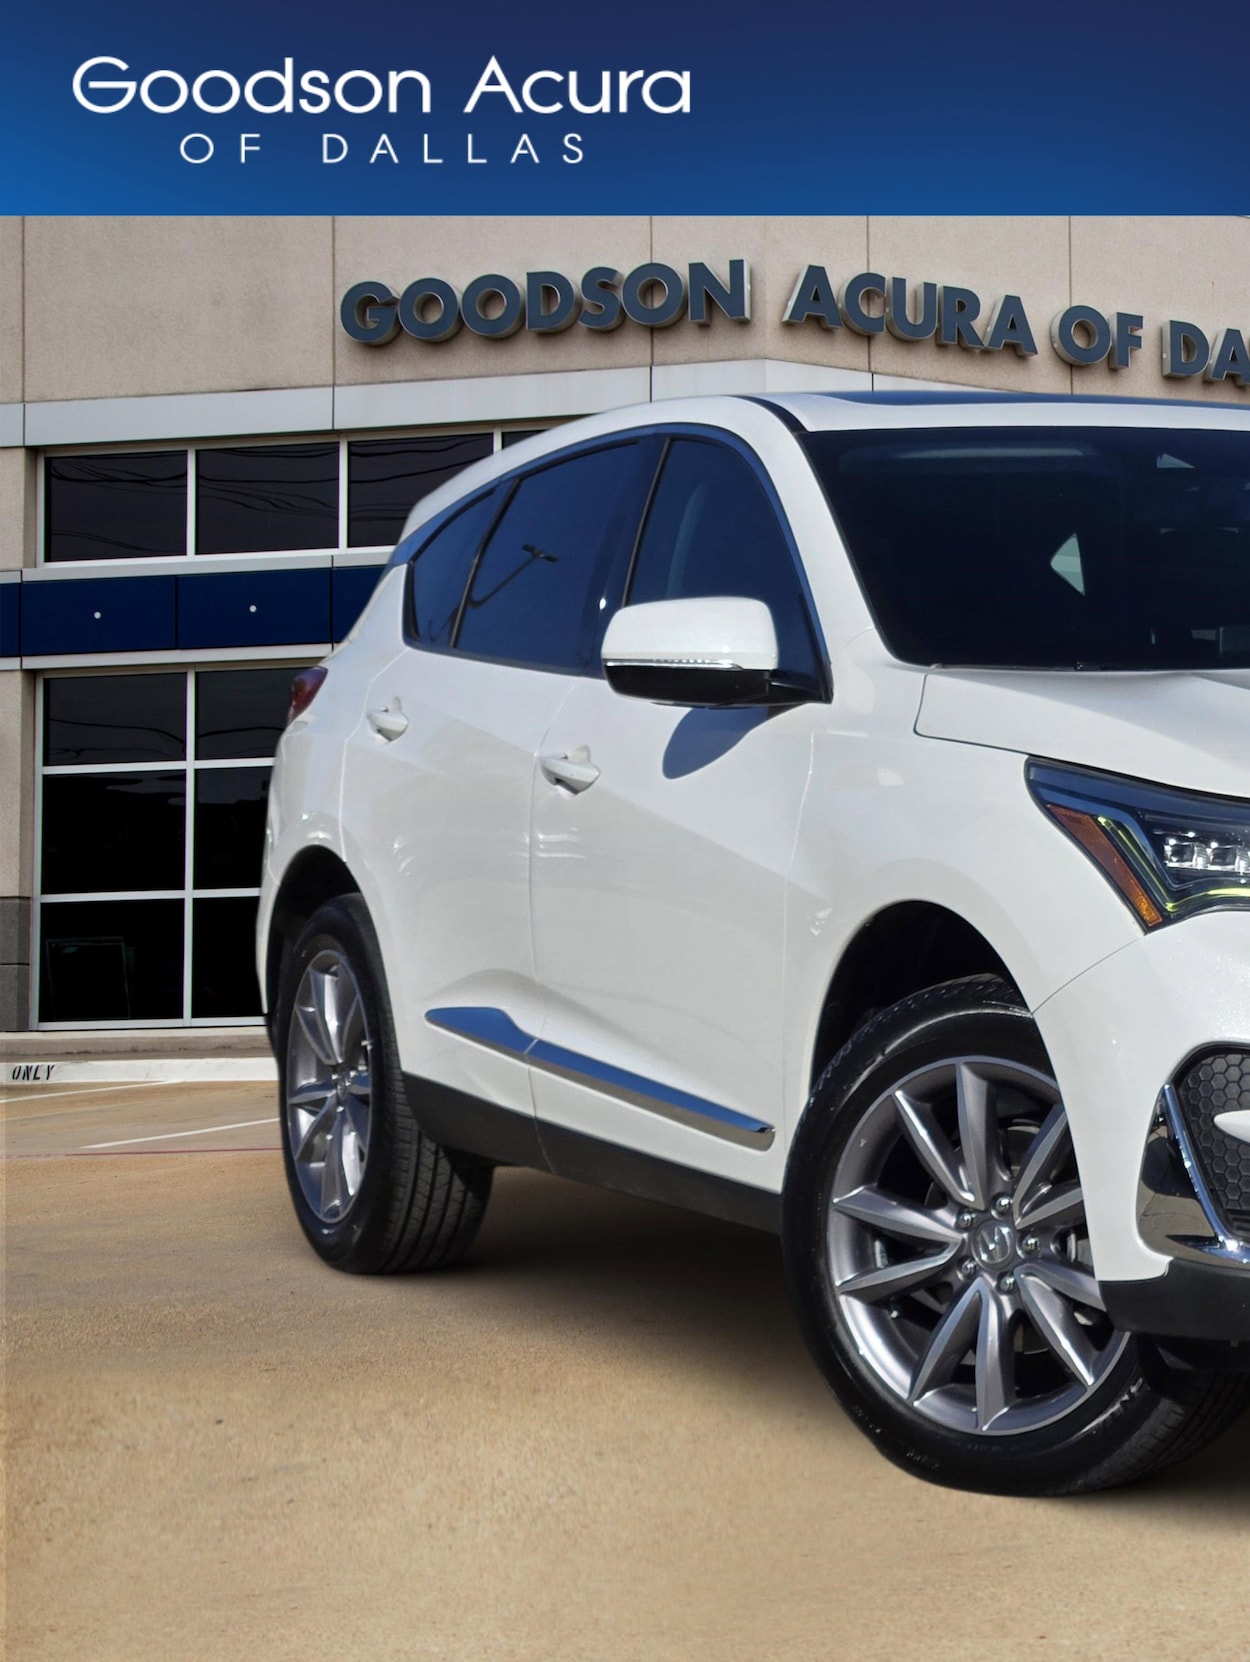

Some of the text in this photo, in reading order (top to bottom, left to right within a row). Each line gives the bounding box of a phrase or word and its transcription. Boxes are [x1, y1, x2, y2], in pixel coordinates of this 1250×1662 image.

[340, 259, 751, 346] GOODSON
[783, 264, 1038, 357] ACURA
[1051, 304, 1143, 370] OF
[12, 1065, 55, 1081] ONLY
